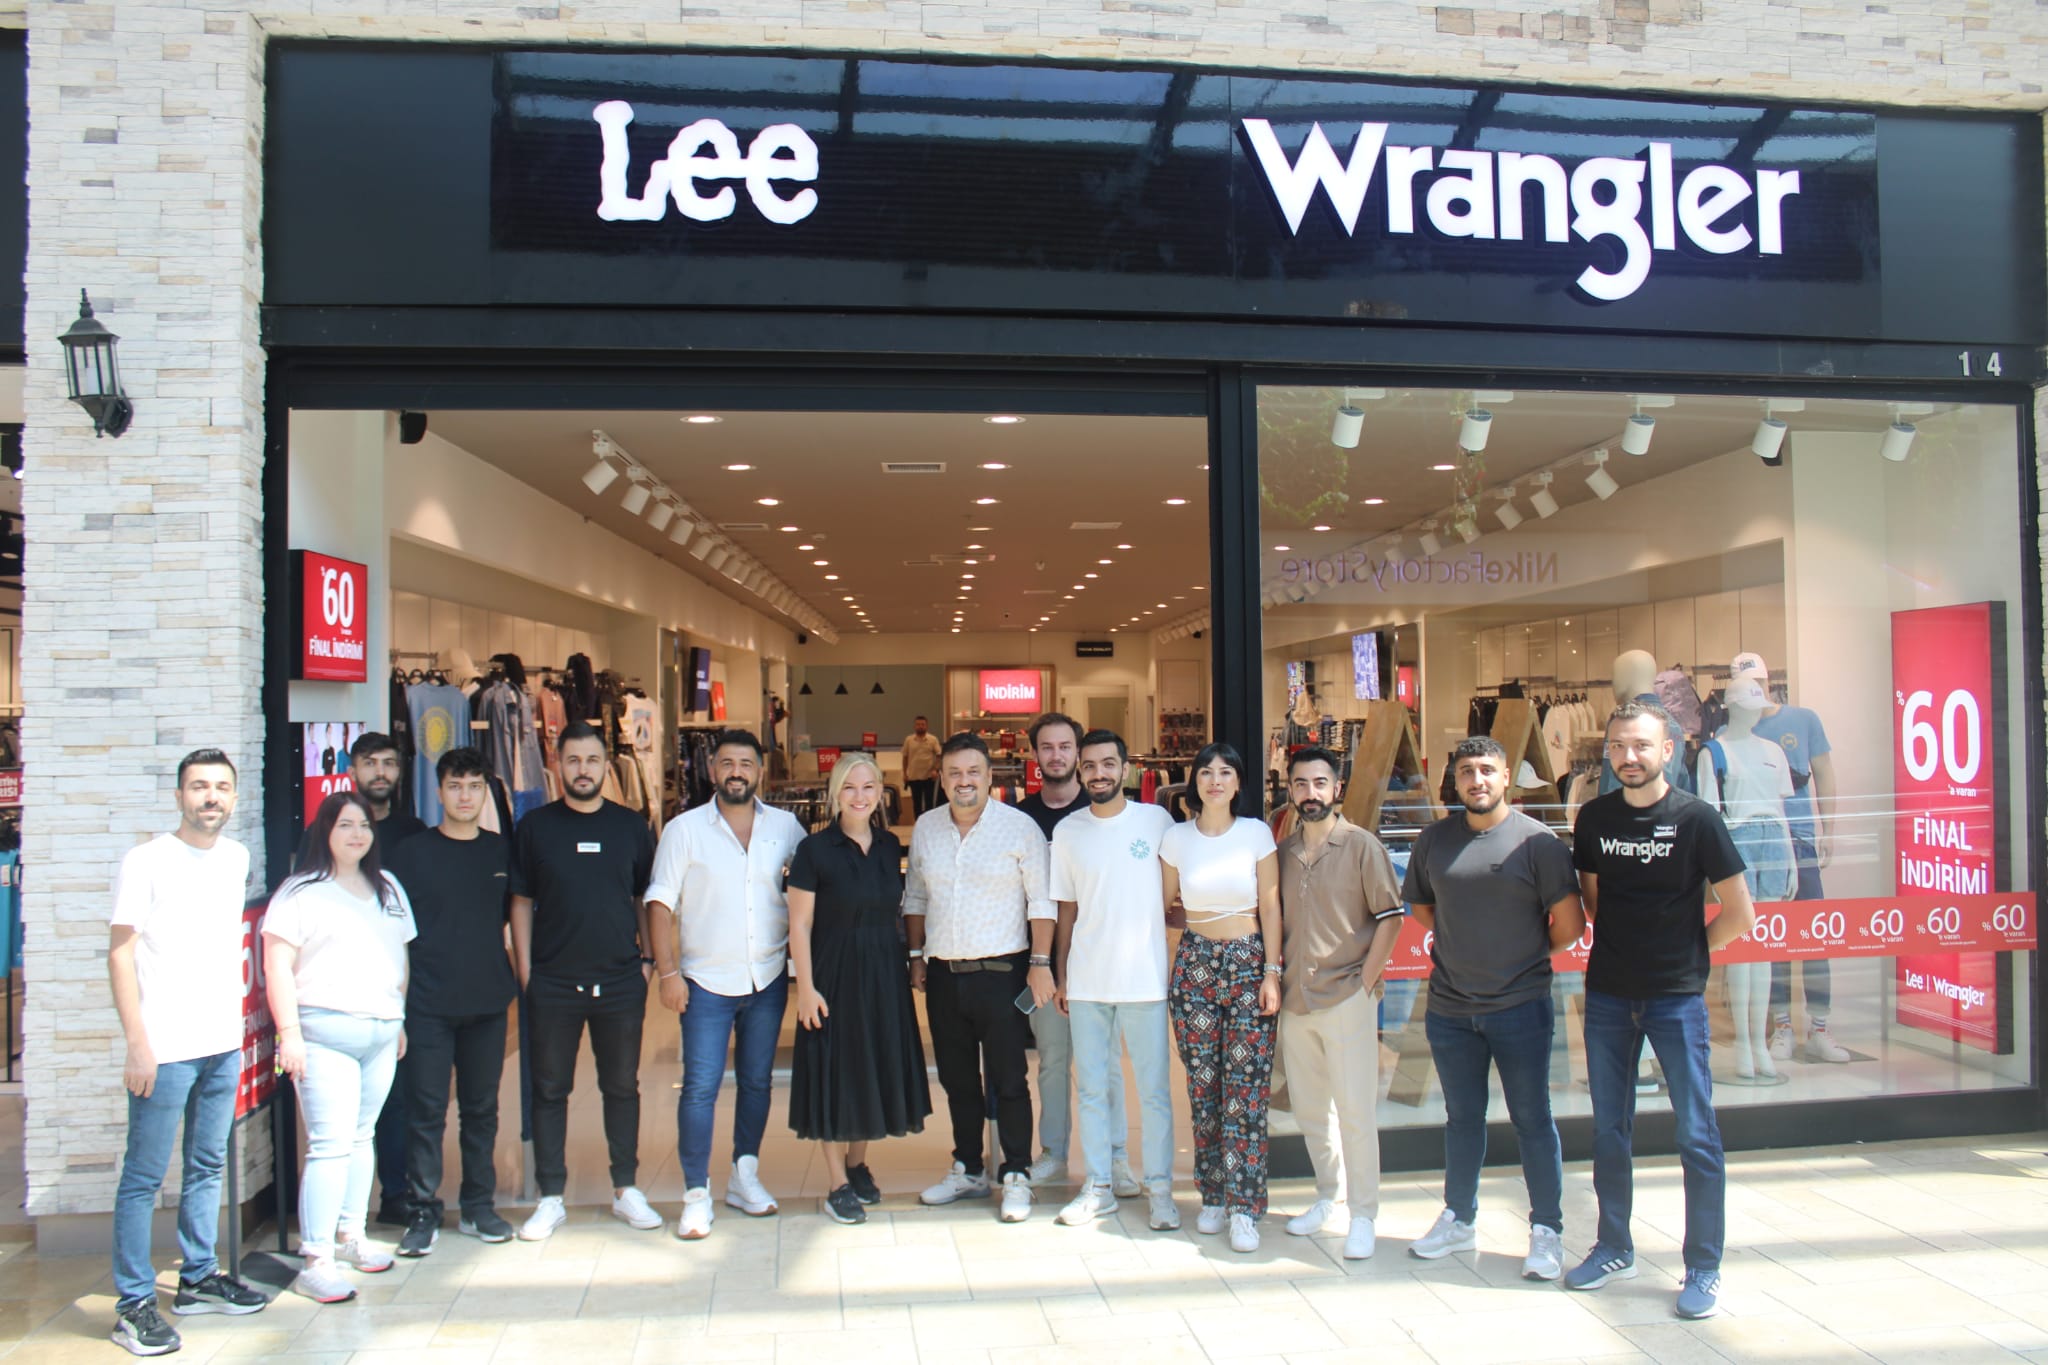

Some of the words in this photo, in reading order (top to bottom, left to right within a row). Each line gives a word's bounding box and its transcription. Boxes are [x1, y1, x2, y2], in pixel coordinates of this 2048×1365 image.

[593, 100, 818, 224] Lee
[1241, 118, 1800, 300] Wrangler
[985, 683, 1035, 700] İNDİRİM
[1956, 786, 1977, 797] varan
[1600, 837, 1674, 864] Wrangler
[1913, 811, 1973, 851] FİNAL
[1901, 850, 1987, 895] İNDİRİMİ
[1905, 969, 1924, 990] Lee
[1933, 975, 1985, 1010] Wrangler
